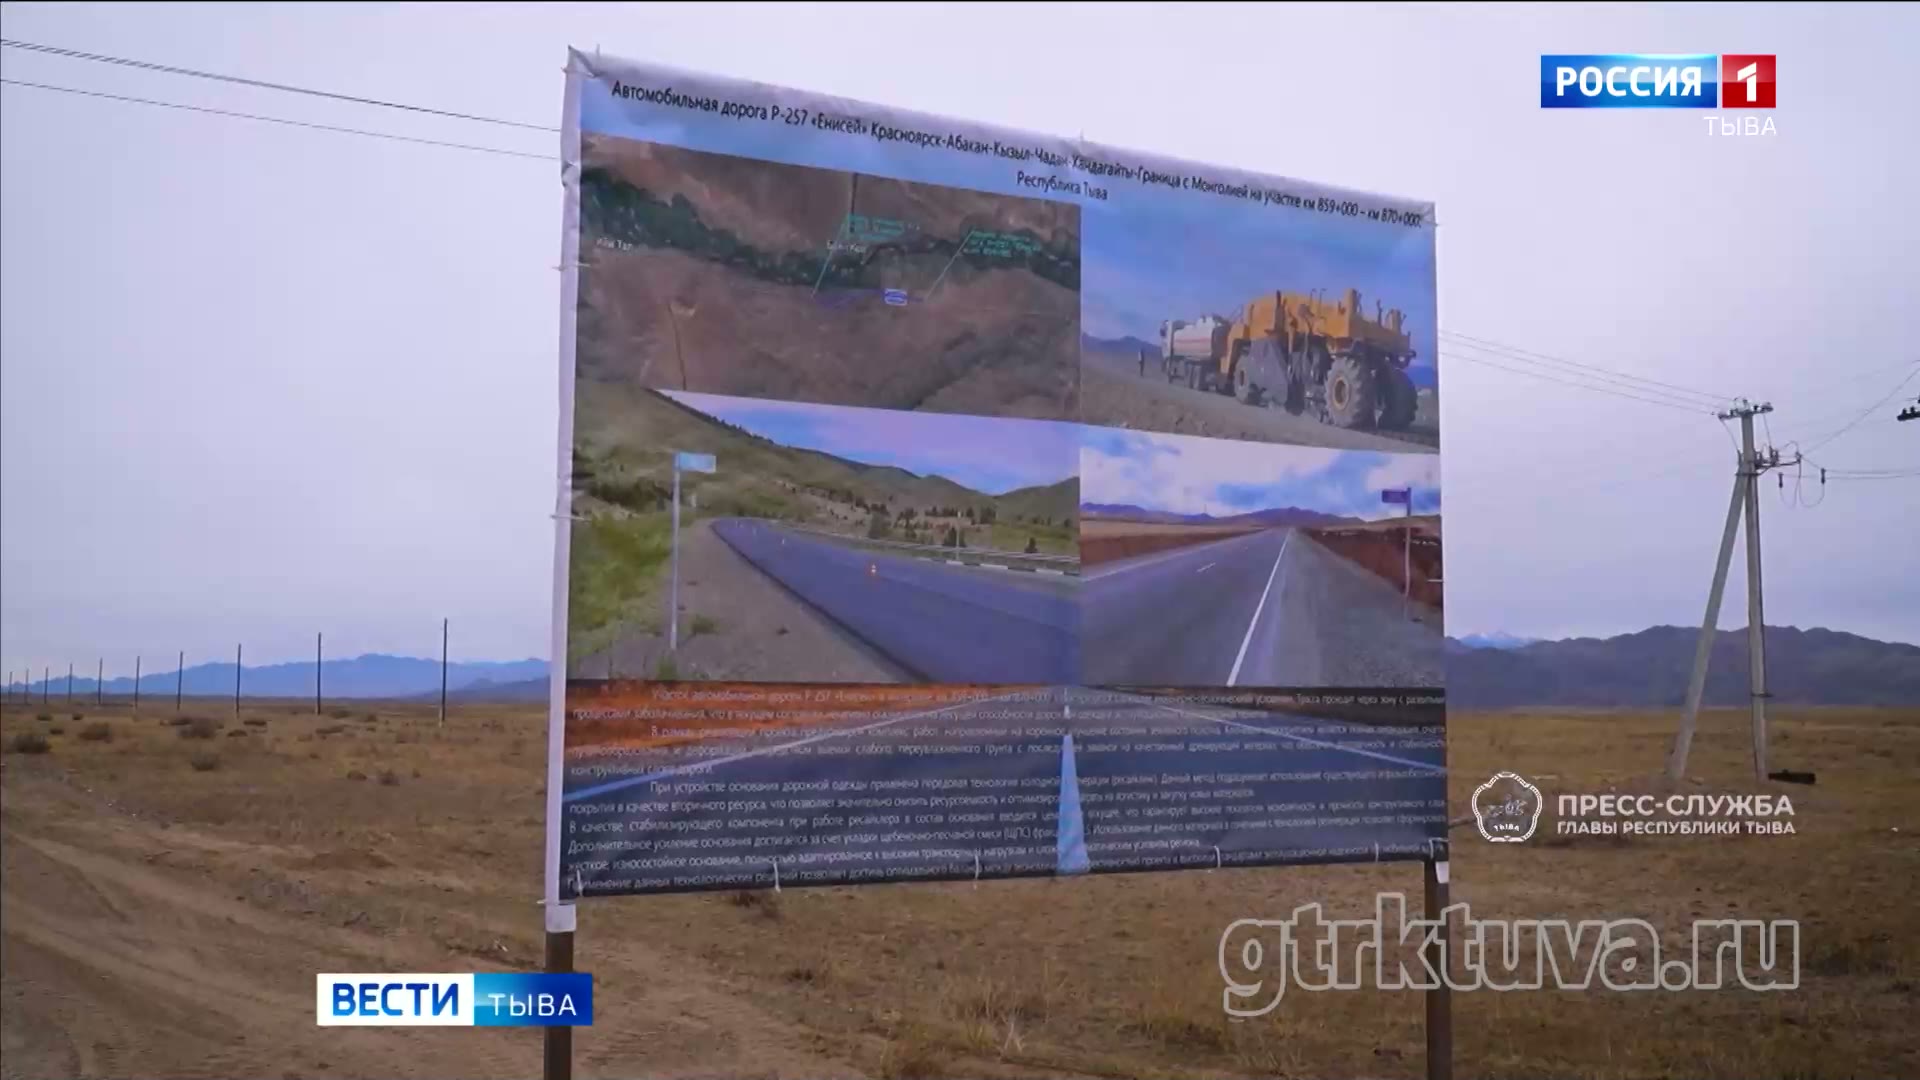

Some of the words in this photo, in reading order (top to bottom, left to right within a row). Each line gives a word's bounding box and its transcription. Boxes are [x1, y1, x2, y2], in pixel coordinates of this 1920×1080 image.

[611, 79, 718, 112] Автомобильная
[721, 101, 767, 121] дорога
[771, 104, 808, 126] Р-257
[811, 113, 868, 135] «Енисей»
[1182, 176, 1189, 189] с
[1191, 177, 1248, 199] Монголией
[1250, 189, 1262, 202] на
[1264, 189, 1301, 208] участке
[1303, 198, 1315, 209] км
[1317, 198, 1359, 217] 859+000
[1367, 210, 1380, 221] км
[1017, 171, 1081, 195] Республика
[1083, 181, 1108, 201] Тыва
[651, 781, 670, 795] При
[674, 781, 726, 795] устройстве
[729, 782, 779, 792] основания
[782, 779, 829, 793] дорожной
[617, 803, 624, 813] в
[626, 801, 669, 813] качестве
[671, 801, 725, 814] вторичного
[569, 820, 577, 833] В
[582, 821, 624, 833] качестве
[629, 818, 723, 833] стабилизирующего
[728, 819, 784, 829] компонента
[813, 813, 844, 828] работе
[915, 814, 944, 824] состав
[567, 839, 652, 855] Дополнительное
